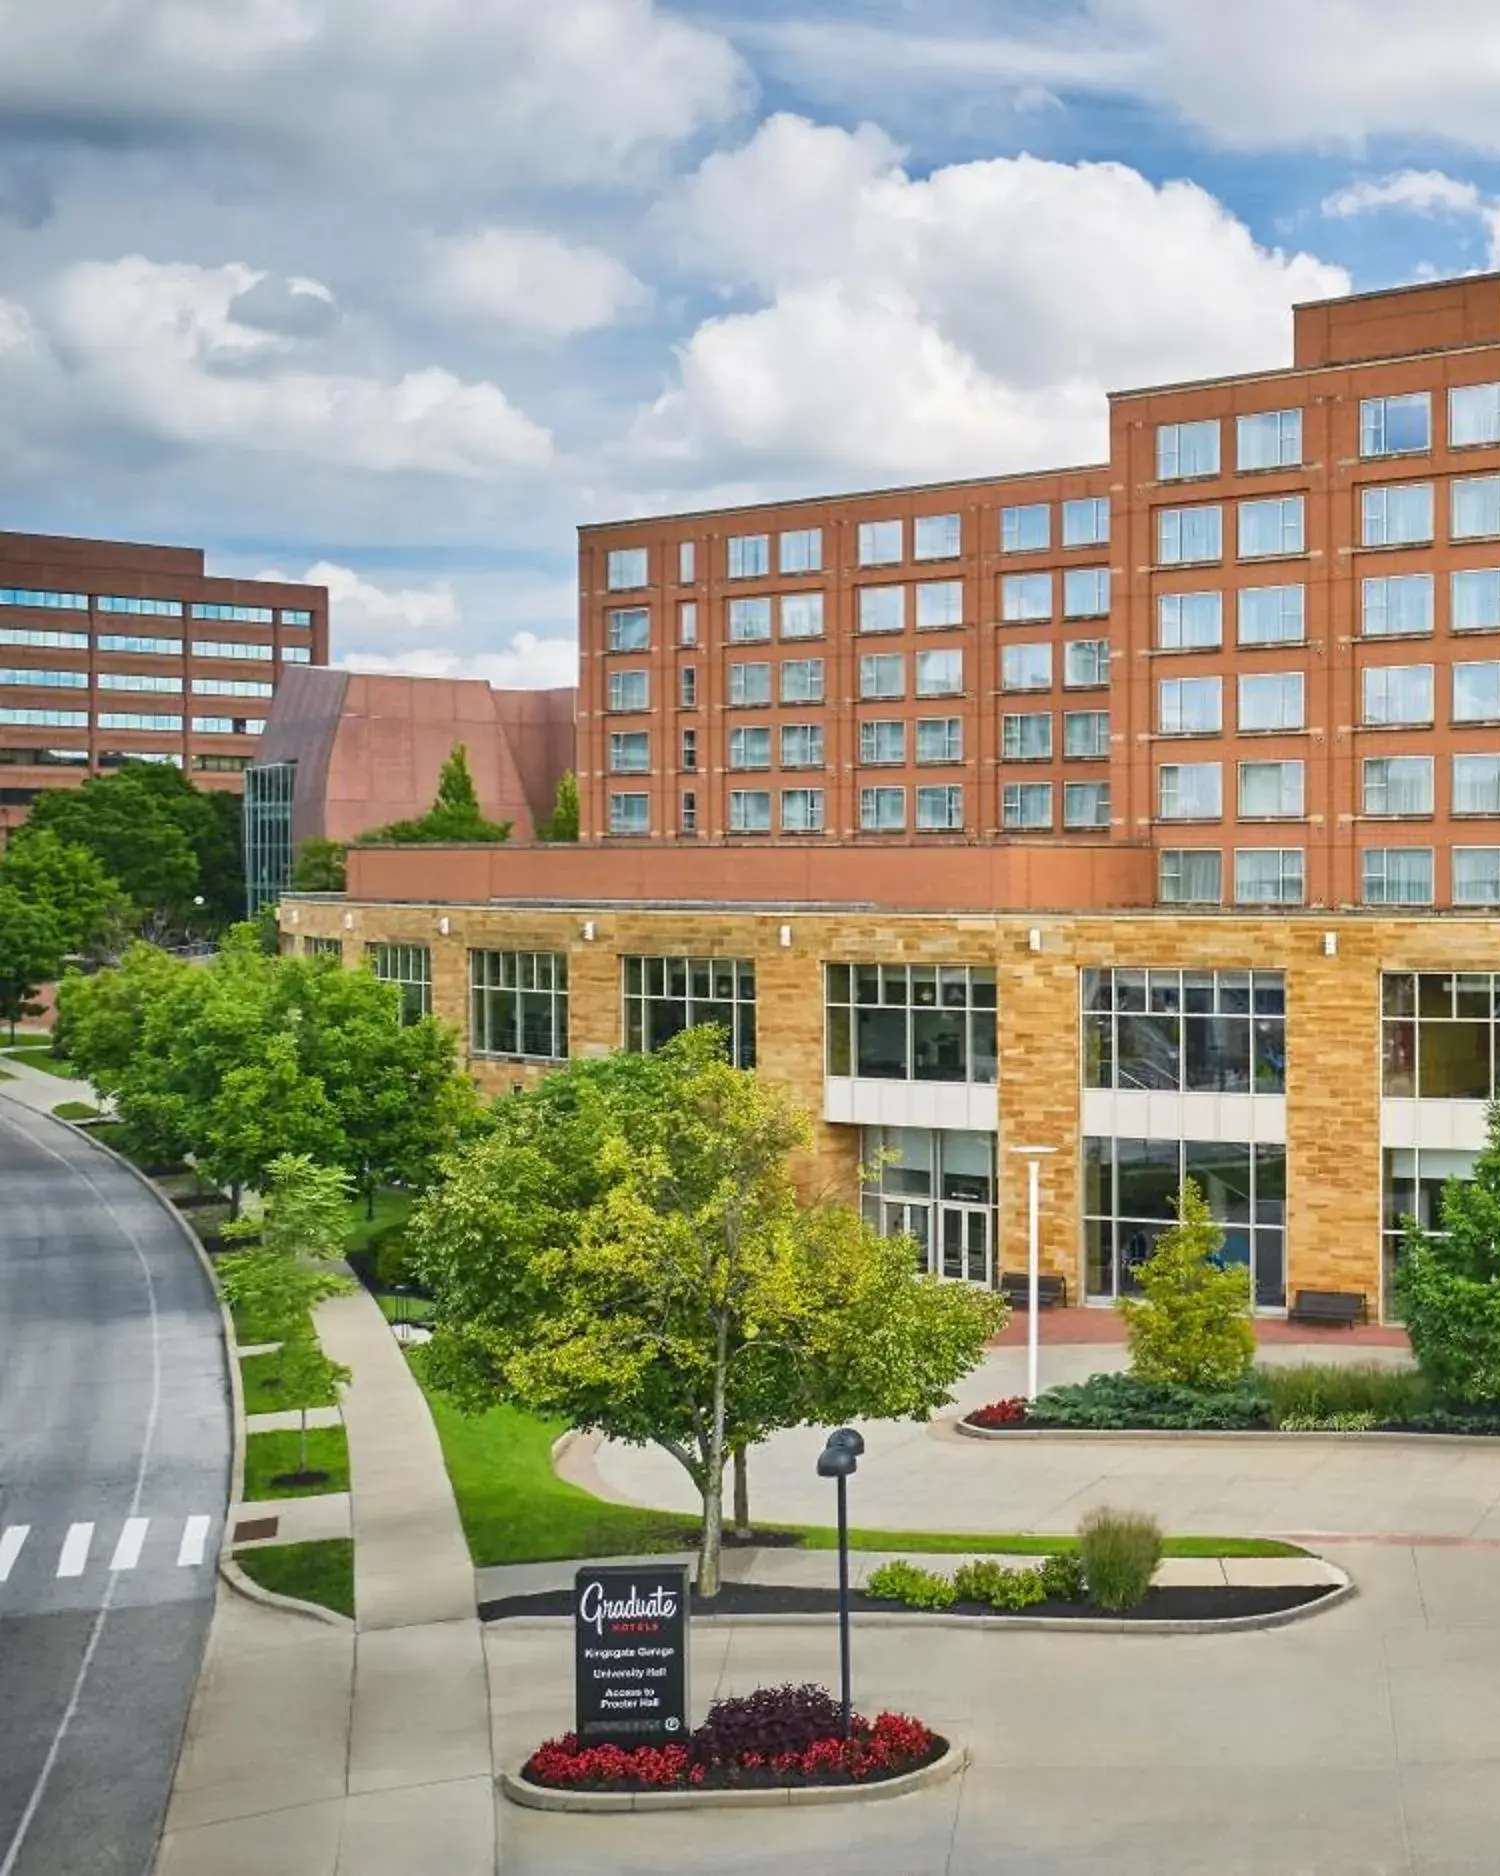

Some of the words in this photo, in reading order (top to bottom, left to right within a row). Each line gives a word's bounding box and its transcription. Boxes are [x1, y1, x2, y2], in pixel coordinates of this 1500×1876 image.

[580, 1581, 678, 1636] Graduate
[610, 1623, 660, 1633] HOTELS
[584, 1648, 635, 1659] Kingsgate
[637, 1647, 675, 1659] Garage
[593, 1666, 645, 1679] University
[646, 1667, 667, 1678] Hall
[604, 1687, 642, 1697] Access
[644, 1687, 655, 1697] to
[639, 1698, 660, 1708] Hall
